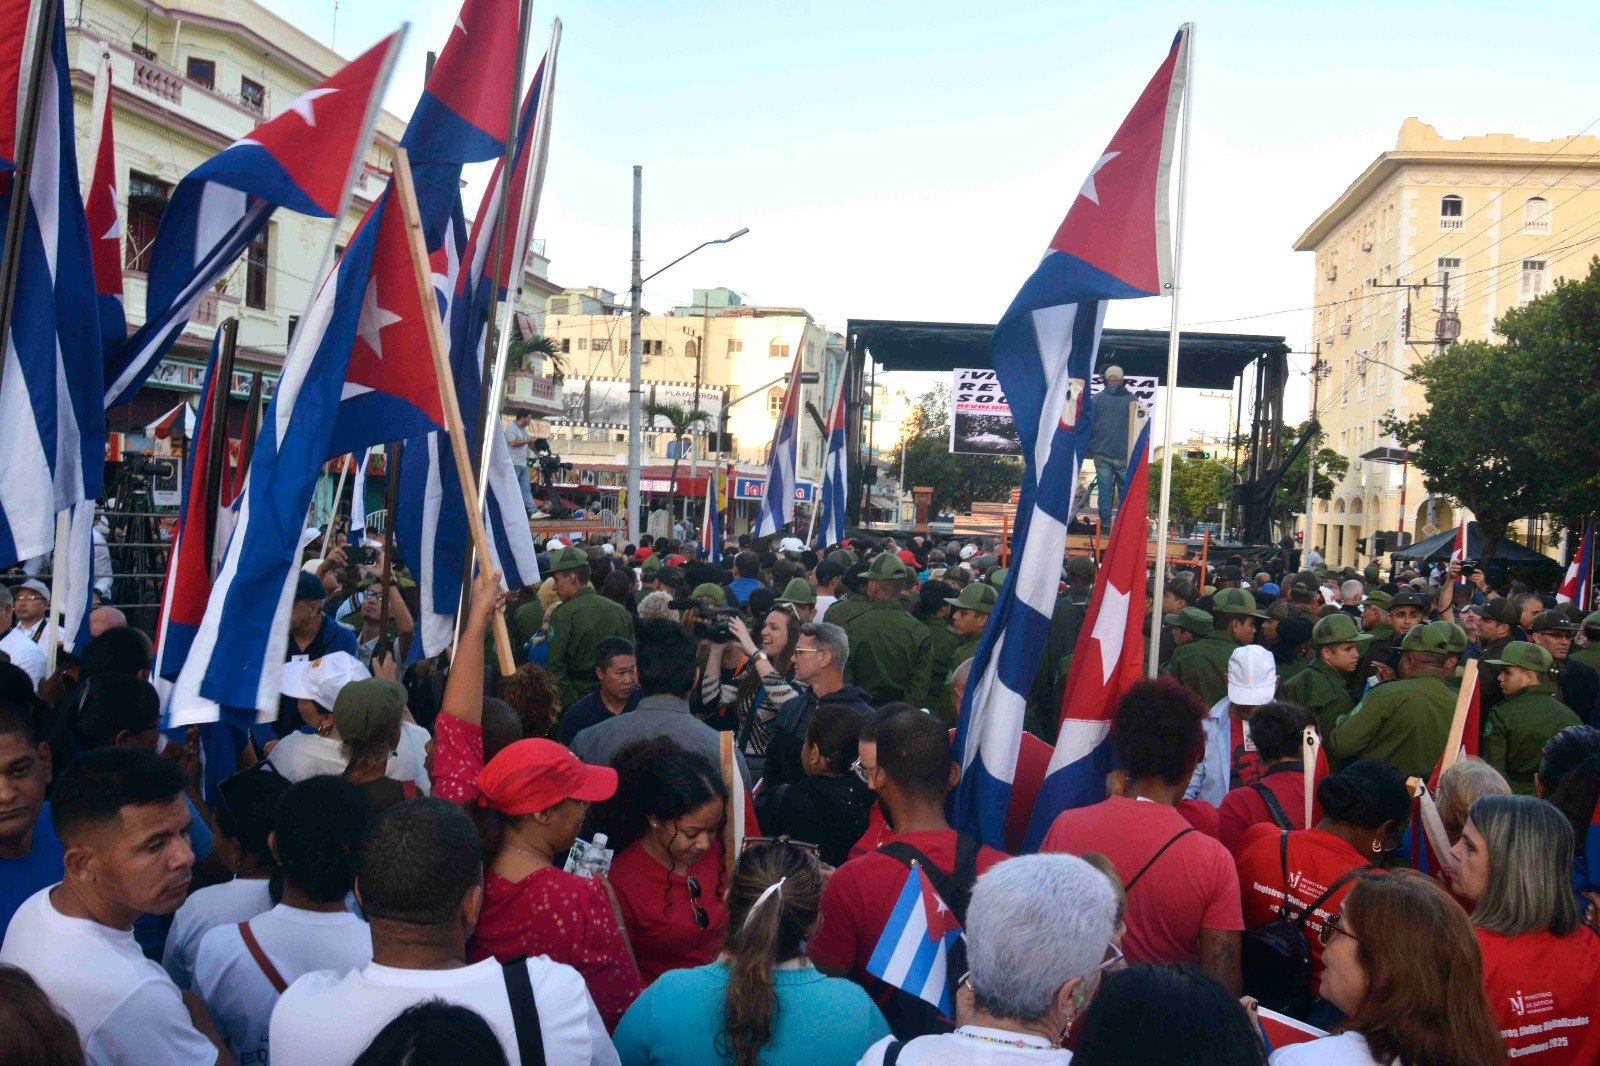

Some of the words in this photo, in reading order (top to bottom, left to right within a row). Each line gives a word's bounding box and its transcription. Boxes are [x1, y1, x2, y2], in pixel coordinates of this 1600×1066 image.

[1302, 878, 1328, 892] MINISTERIO
[1253, 881, 1286, 900] Registros
[1286, 893, 1308, 910] Civiles
[1524, 991, 1553, 1001] MINISTERIO
[1533, 999, 1554, 1009] JUSTICIA
[1519, 1024, 1543, 1037] Civiles
[1543, 1016, 1590, 1031] Digitalizados
[1549, 1036, 1569, 1049] 2025
